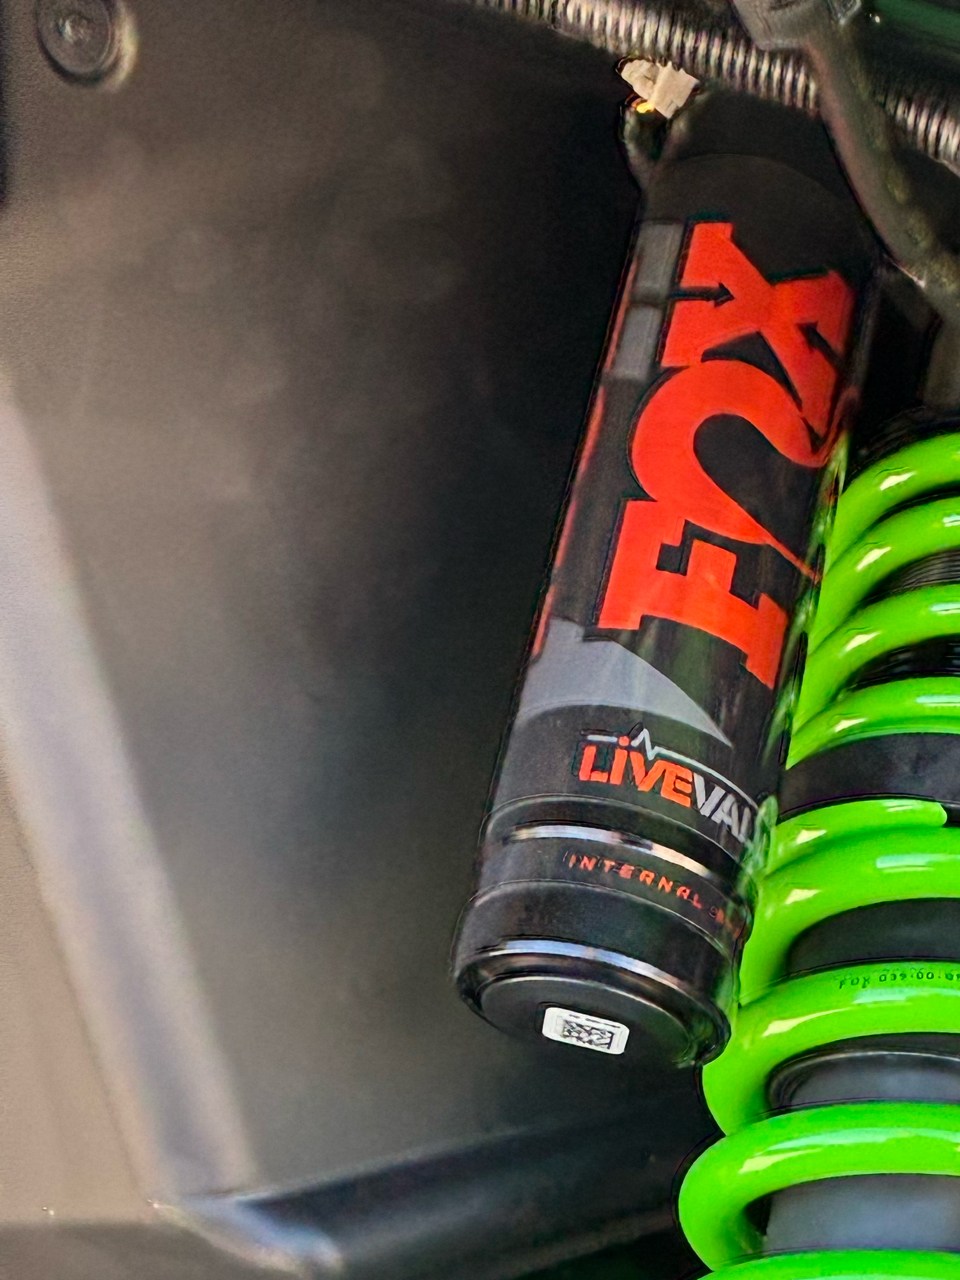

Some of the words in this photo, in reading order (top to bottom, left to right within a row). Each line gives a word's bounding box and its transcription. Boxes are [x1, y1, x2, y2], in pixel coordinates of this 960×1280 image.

[597, 221, 855, 690] FOX
[567, 852, 703, 909] INTERNAL
[838, 974, 872, 990] FOX
